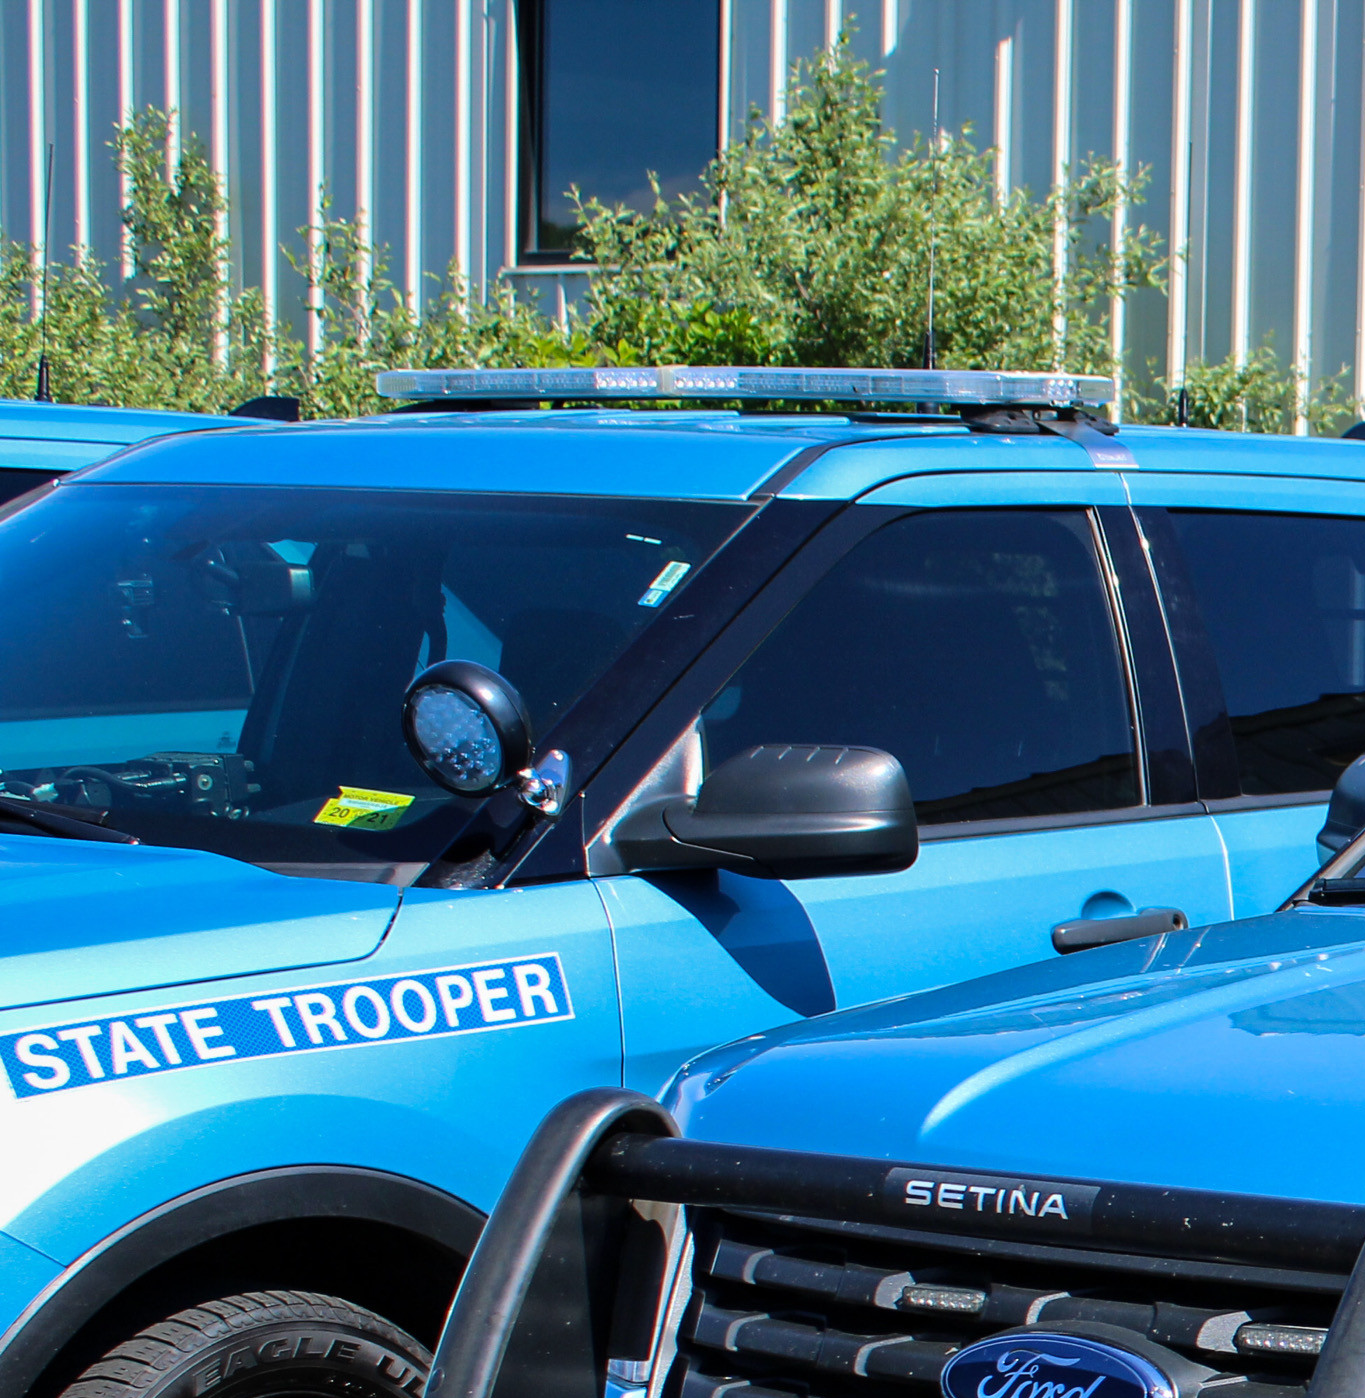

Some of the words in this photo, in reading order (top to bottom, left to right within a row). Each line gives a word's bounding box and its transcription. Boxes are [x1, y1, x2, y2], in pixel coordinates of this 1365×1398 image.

[329, 806, 350, 818] 20
[366, 812, 388, 824] 21
[15, 1008, 236, 1089] STATE
[252, 963, 559, 1047] TROOPER
[905, 1179, 1068, 1220] SETINA
[192, 1337, 362, 1397] EAGLE
[376, 1355, 425, 1398] UL
